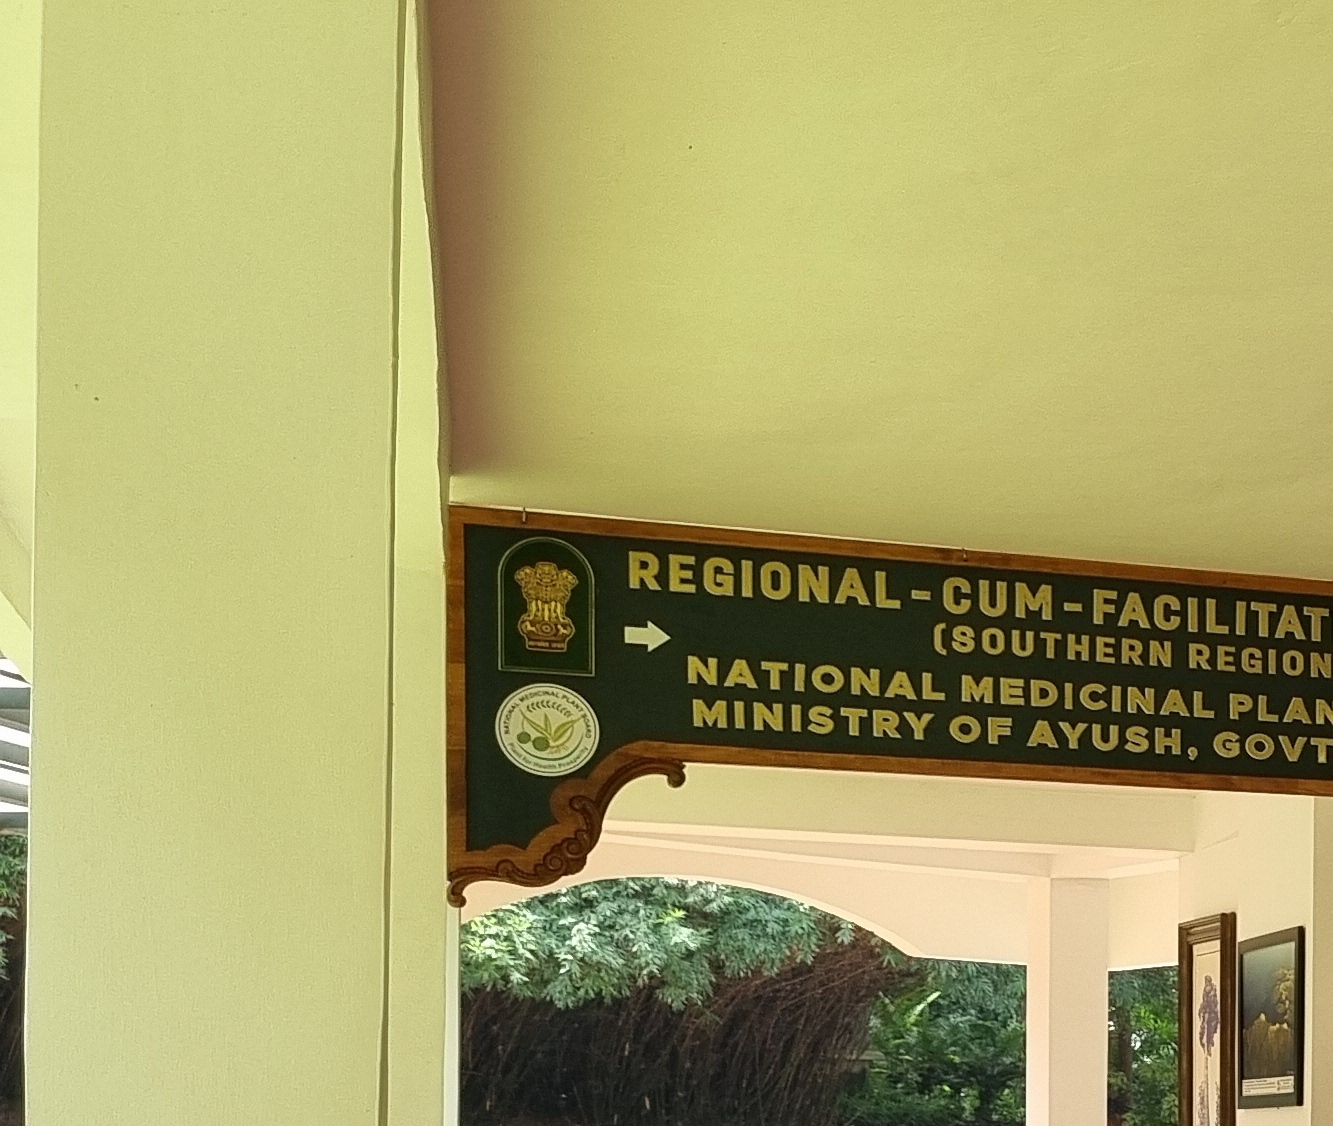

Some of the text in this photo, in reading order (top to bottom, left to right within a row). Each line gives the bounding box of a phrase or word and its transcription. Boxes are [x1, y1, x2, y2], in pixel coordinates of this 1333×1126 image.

[933, 622, 1173, 668] (SOUTHERN
[687, 655, 946, 701] NATIONAL
[960, 674, 1215, 719] MEDICINAL
[692, 698, 935, 741] MINISTRY
[949, 715, 1013, 745] OF
[1026, 719, 1199, 761] AYUSH,
